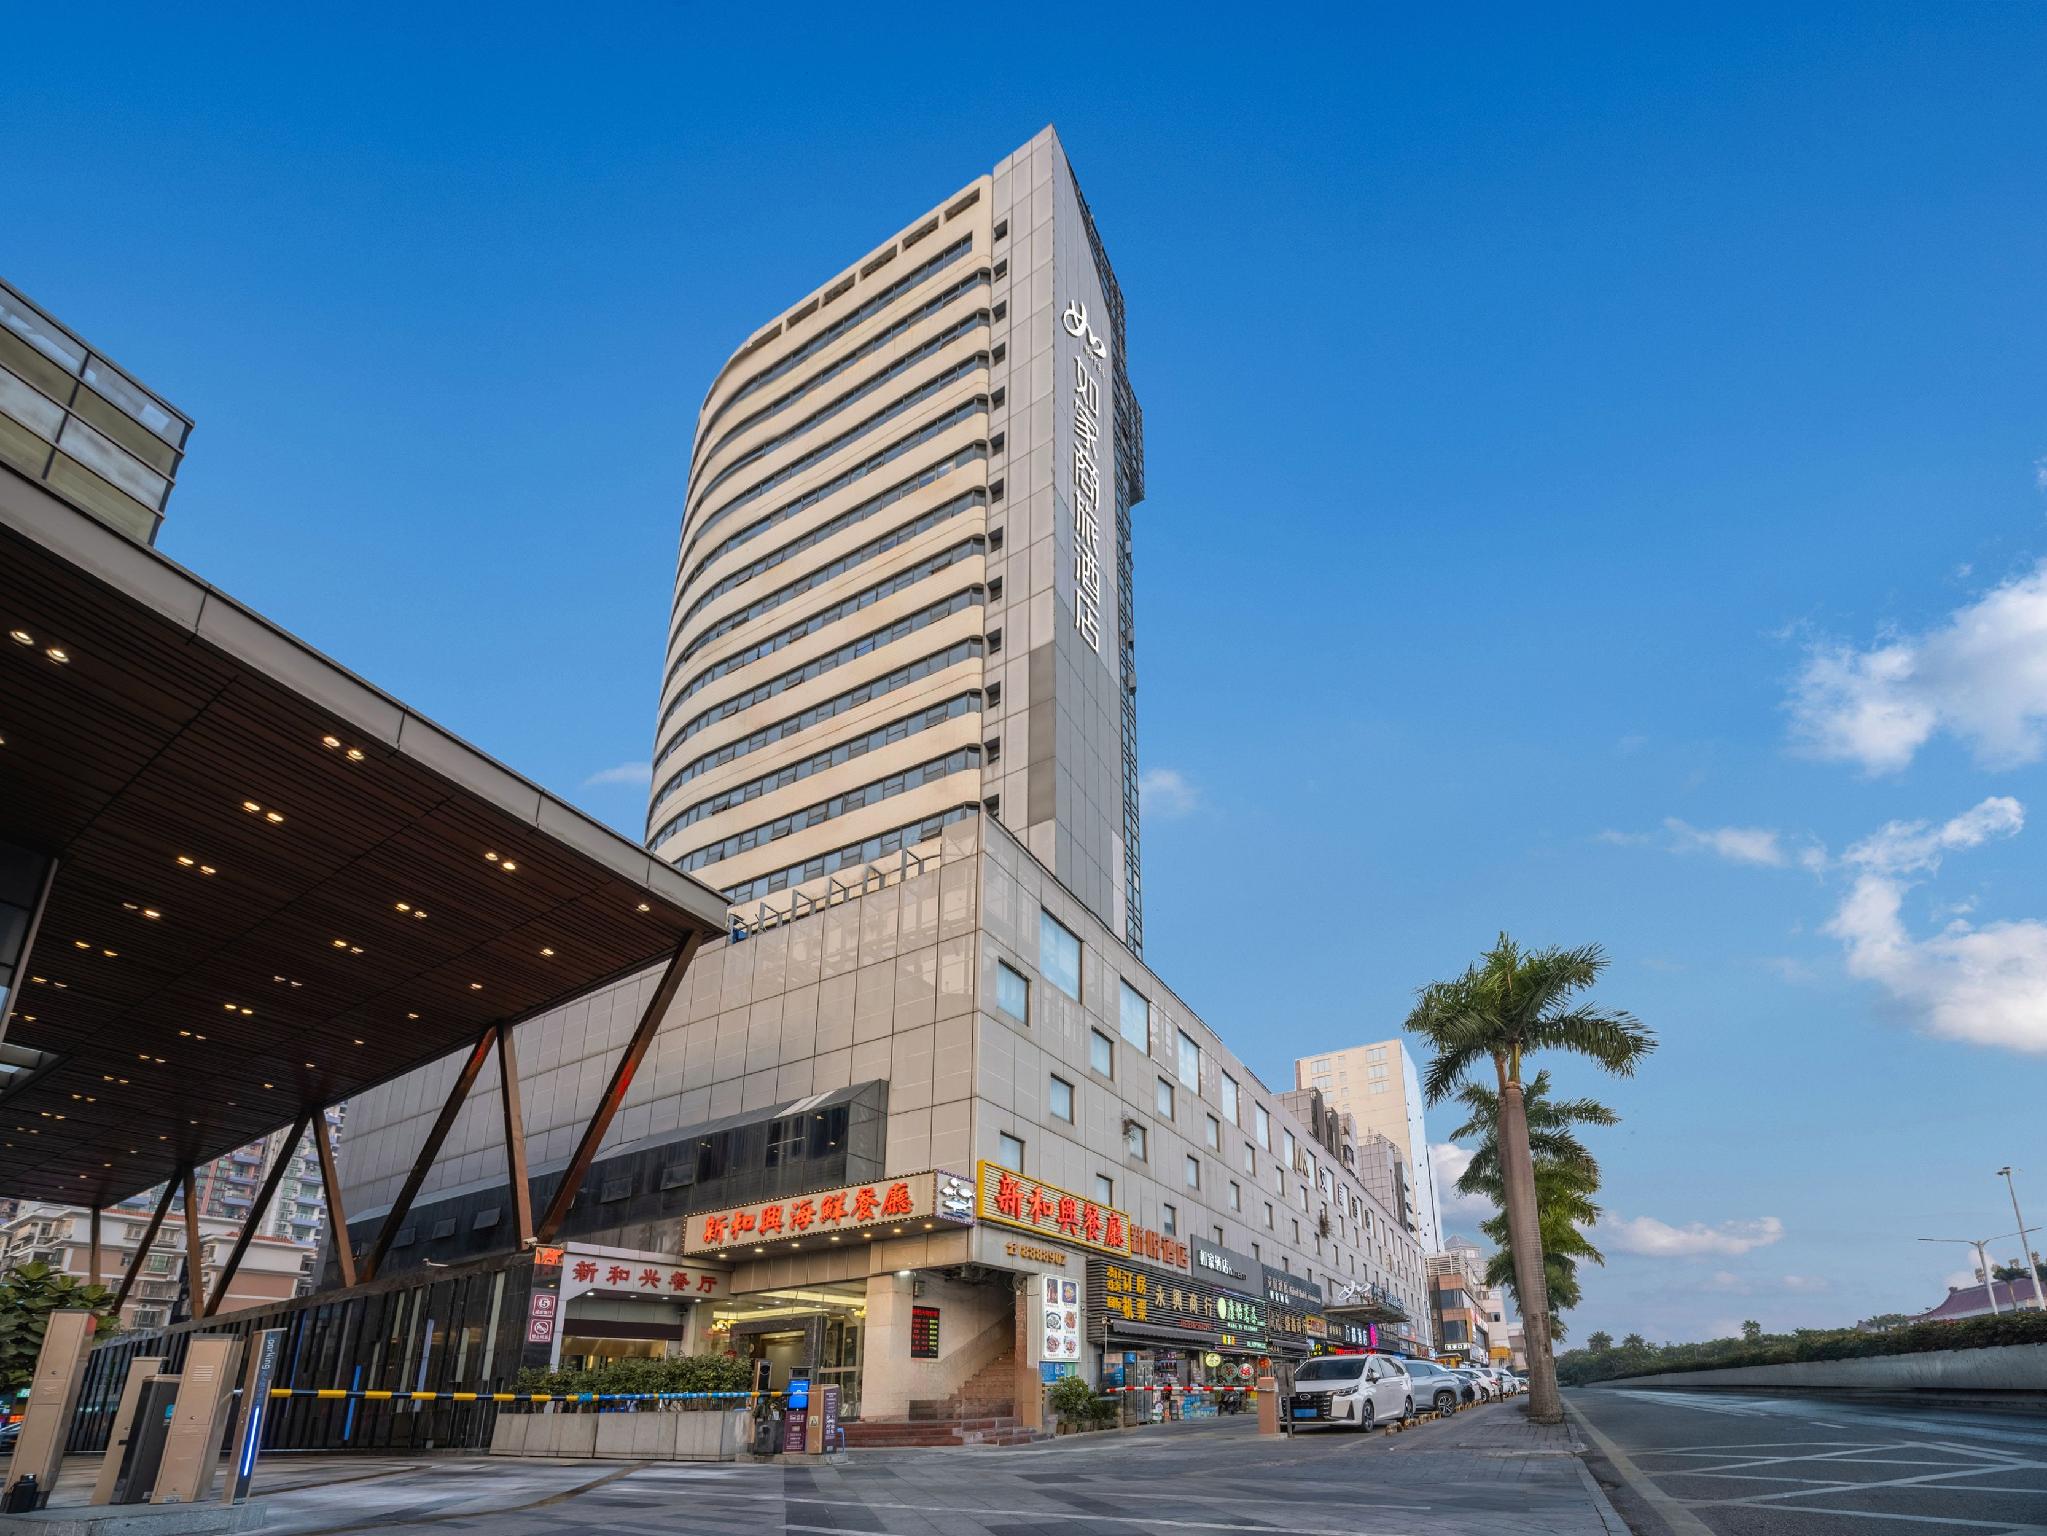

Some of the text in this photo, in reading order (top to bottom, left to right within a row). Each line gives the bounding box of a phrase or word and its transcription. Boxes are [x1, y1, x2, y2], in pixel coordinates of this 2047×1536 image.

[1074, 355, 1100, 655] 如家商旅酒店
[703, 1182, 914, 1246] 新和興海鮮餐廳
[995, 1172, 1124, 1248] 新和興餐廳
[572, 1260, 719, 1294] 新和兴餐厅
[1154, 1284, 1214, 1317] 永興商行
